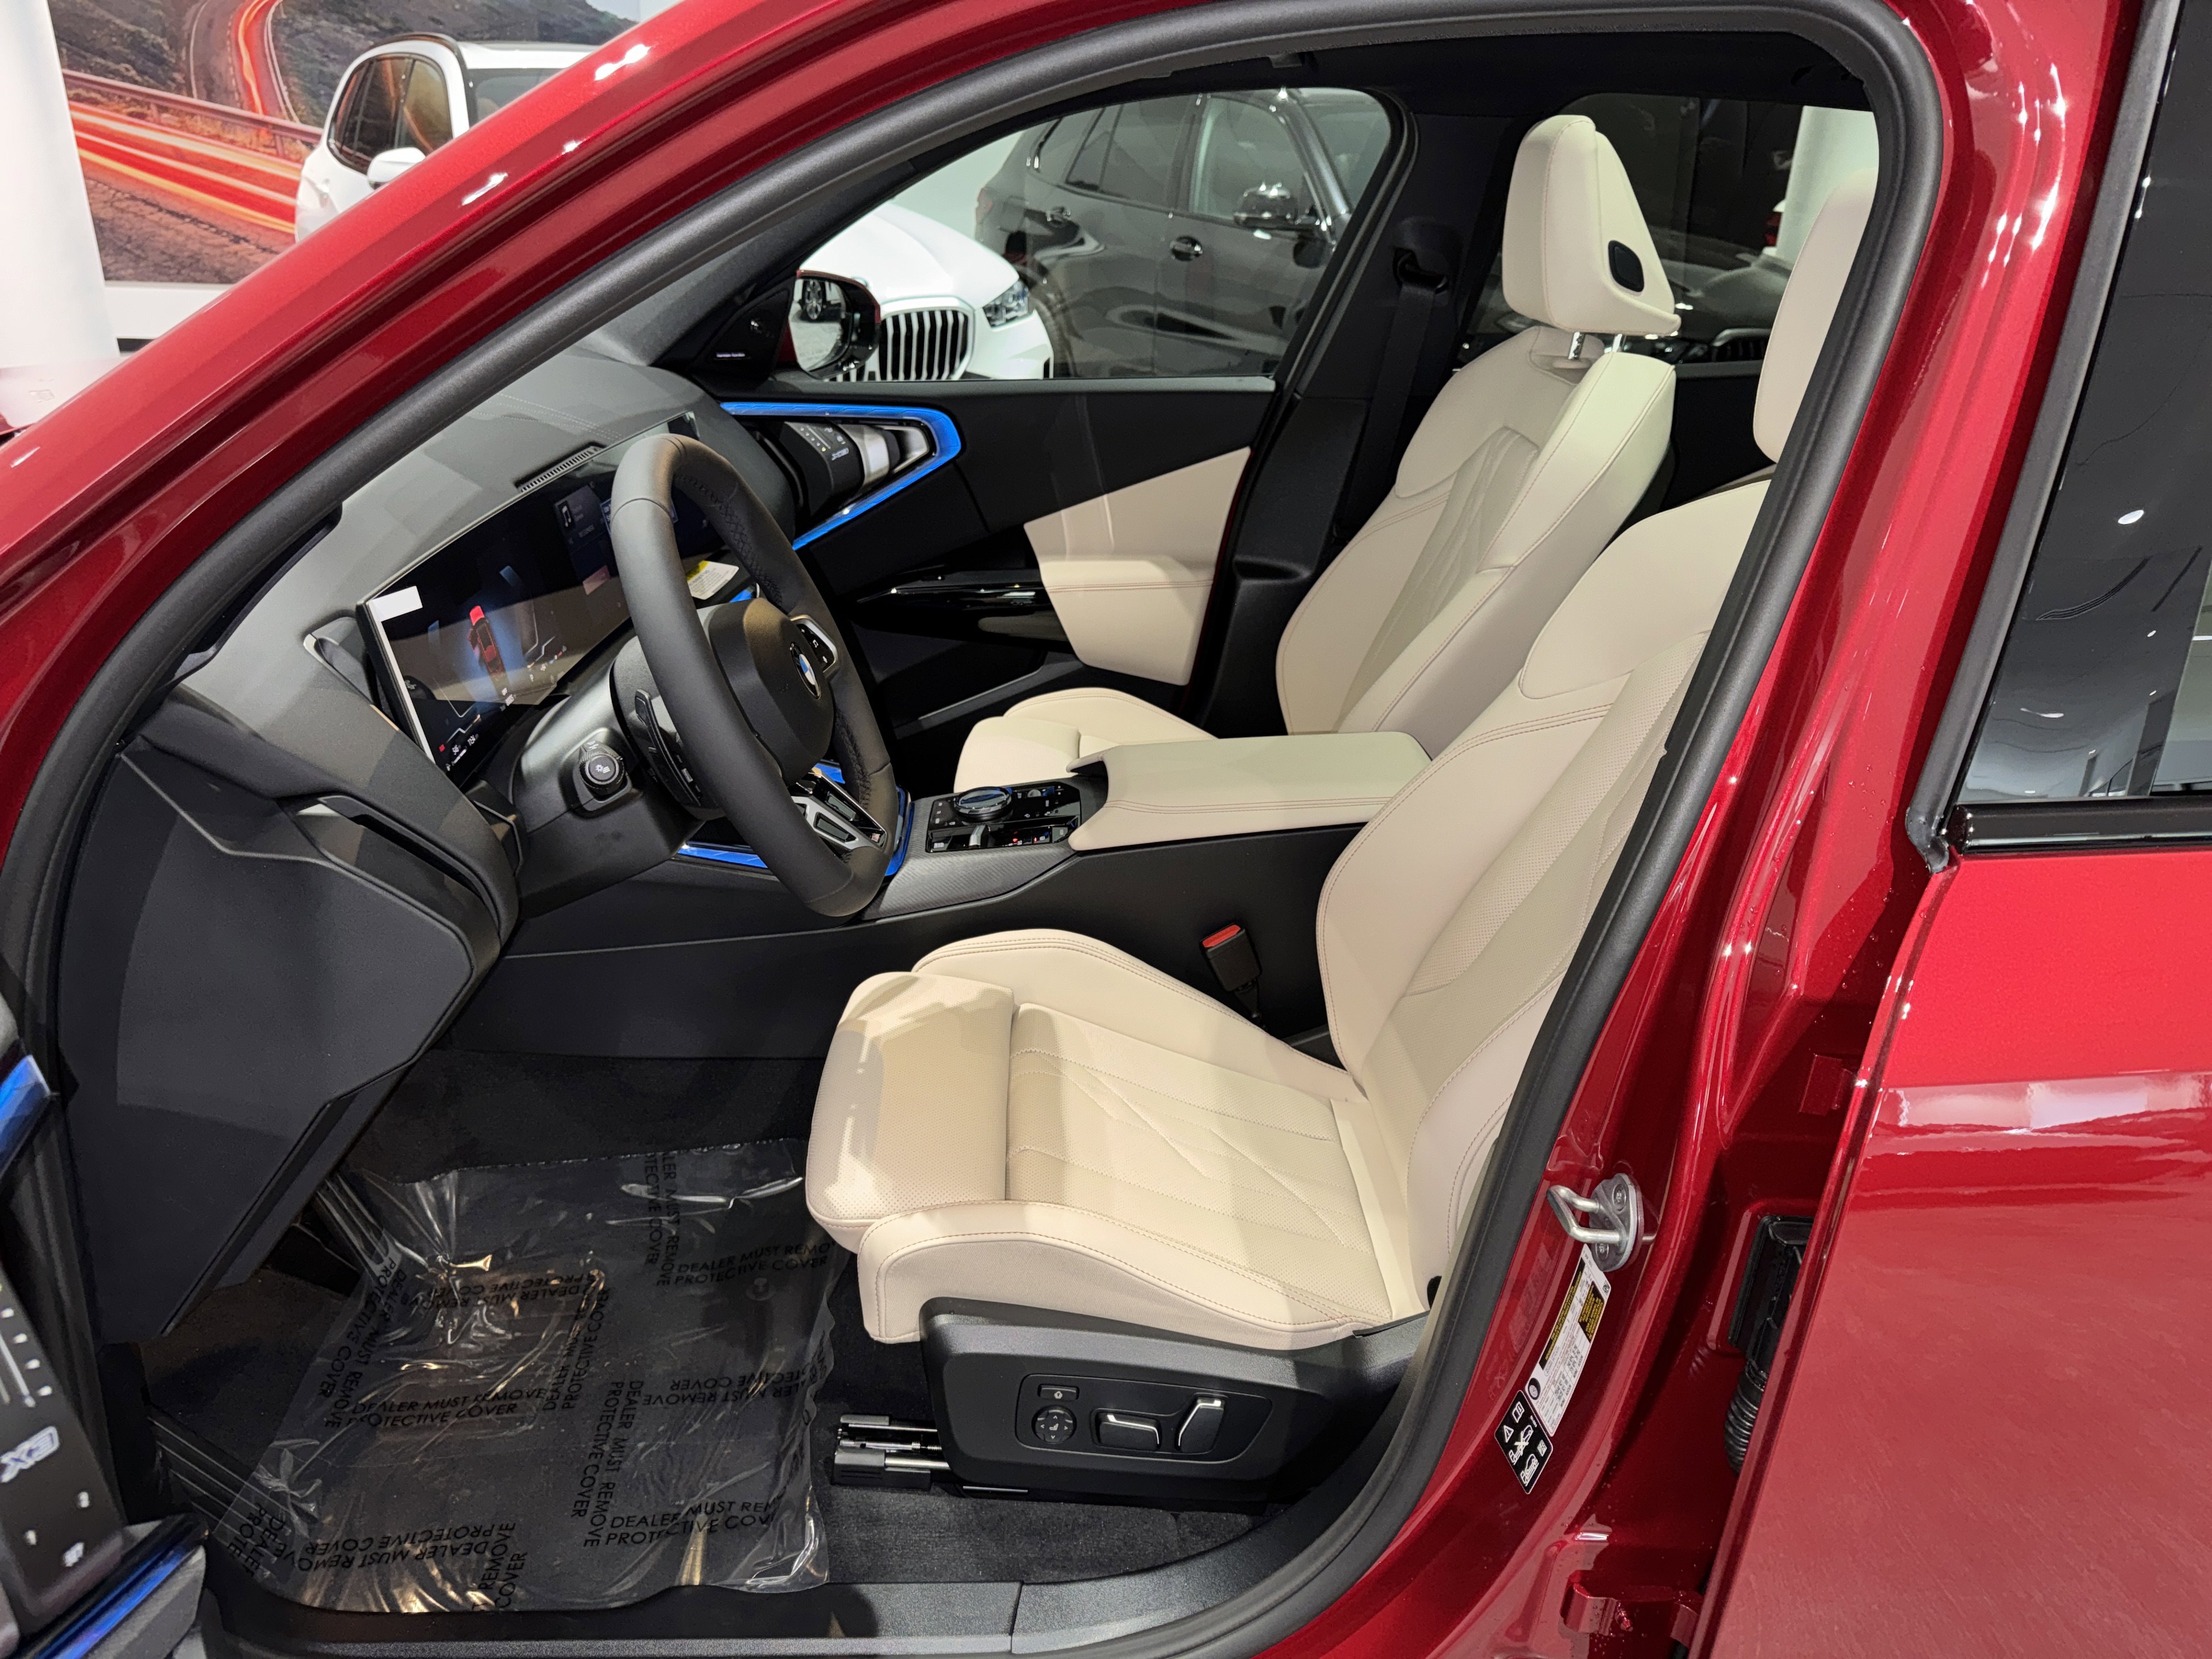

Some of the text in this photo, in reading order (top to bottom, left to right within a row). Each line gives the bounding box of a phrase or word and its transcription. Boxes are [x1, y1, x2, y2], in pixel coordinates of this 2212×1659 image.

[657, 1235, 680, 1286] REMOVE
[675, 1262, 764, 1285] PROTECTIVE
[678, 1256, 736, 1273] DEALER
[741, 1245, 780, 1263] MUST
[520, 1285, 579, 1300] DEALER
[325, 1269, 407, 1427] DEALER MUST REMOVE
[317, 1346, 352, 1397] COVER
[562, 1335, 597, 1409] PROTECTIVE
[670, 1376, 732, 1391] COVER
[352, 1401, 419, 1414] DEALER
[422, 1396, 471, 1412] MUST
[456, 1403, 517, 1418] COVER
[643, 1392, 717, 1405] REMOVE
[571, 1382, 625, 1517] PROTECTIVE COVER
[584, 1381, 644, 1547] DEALER MUST REMOVE
[685, 1502, 736, 1515] MUST
[725, 1514, 774, 1529] COV
[305, 1524, 494, 1555] PROTECTIVE COVER
[273, 1541, 488, 1571] DEALER MUST REMOVE
[477, 1522, 516, 1590] REMOVE
[494, 1551, 527, 1608] COVER
